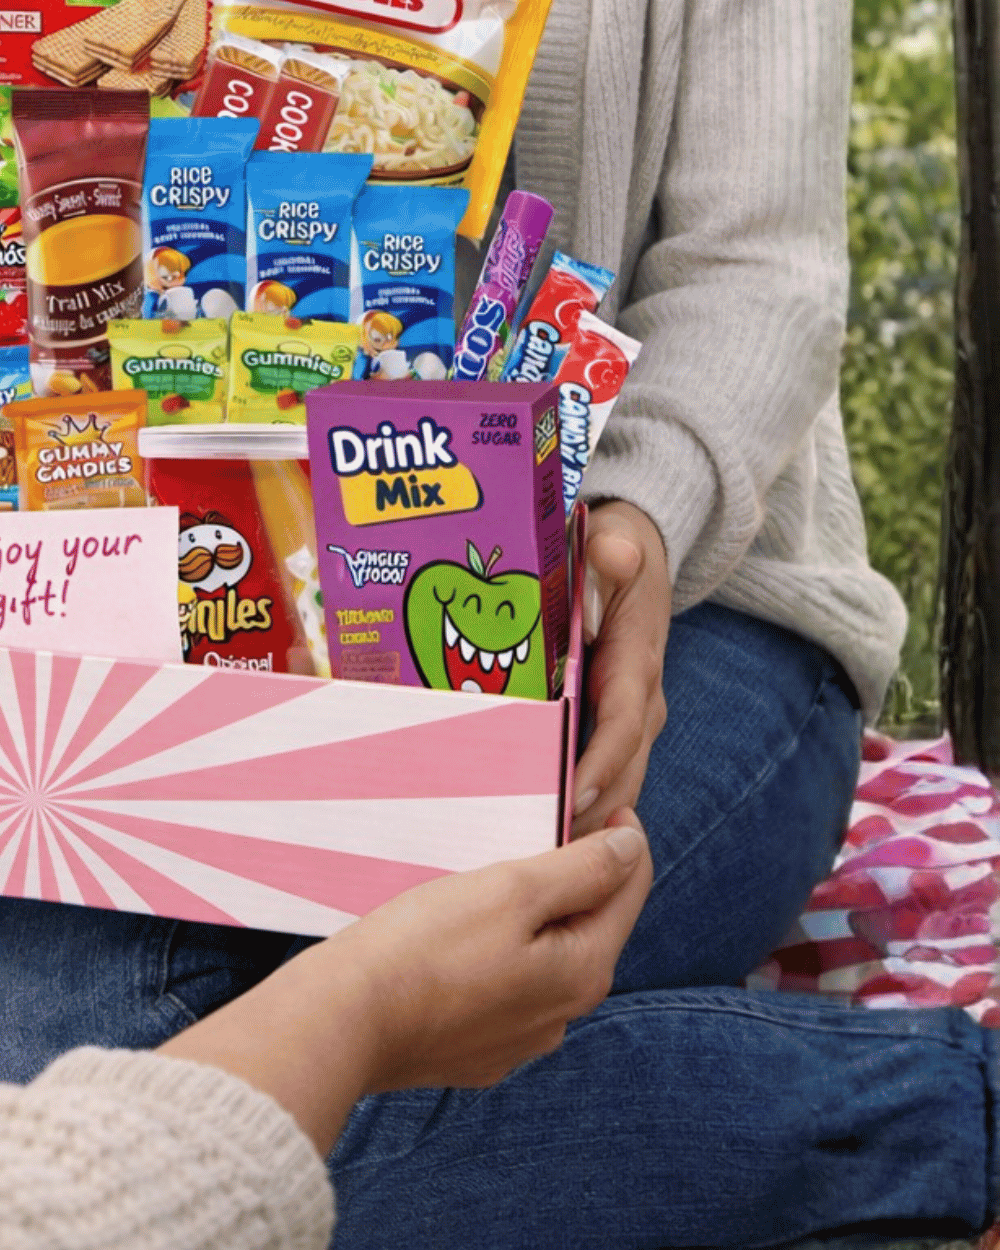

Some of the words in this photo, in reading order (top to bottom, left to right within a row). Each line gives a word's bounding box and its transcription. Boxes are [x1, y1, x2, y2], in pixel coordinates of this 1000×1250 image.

[151, 185, 231, 208] CRISPY
[258, 219, 338, 242] CRISPY
[364, 250, 442, 273] CRISPY
[479, 414, 519, 429] ZERO
[331, 421, 455, 473] Drink
[471, 431, 522, 446] SUGAR
[38, 441, 123, 464] GUMMY
[36, 457, 132, 483] CANDIES
[375, 474, 446, 512] Mix
[62, 533, 143, 576] your
